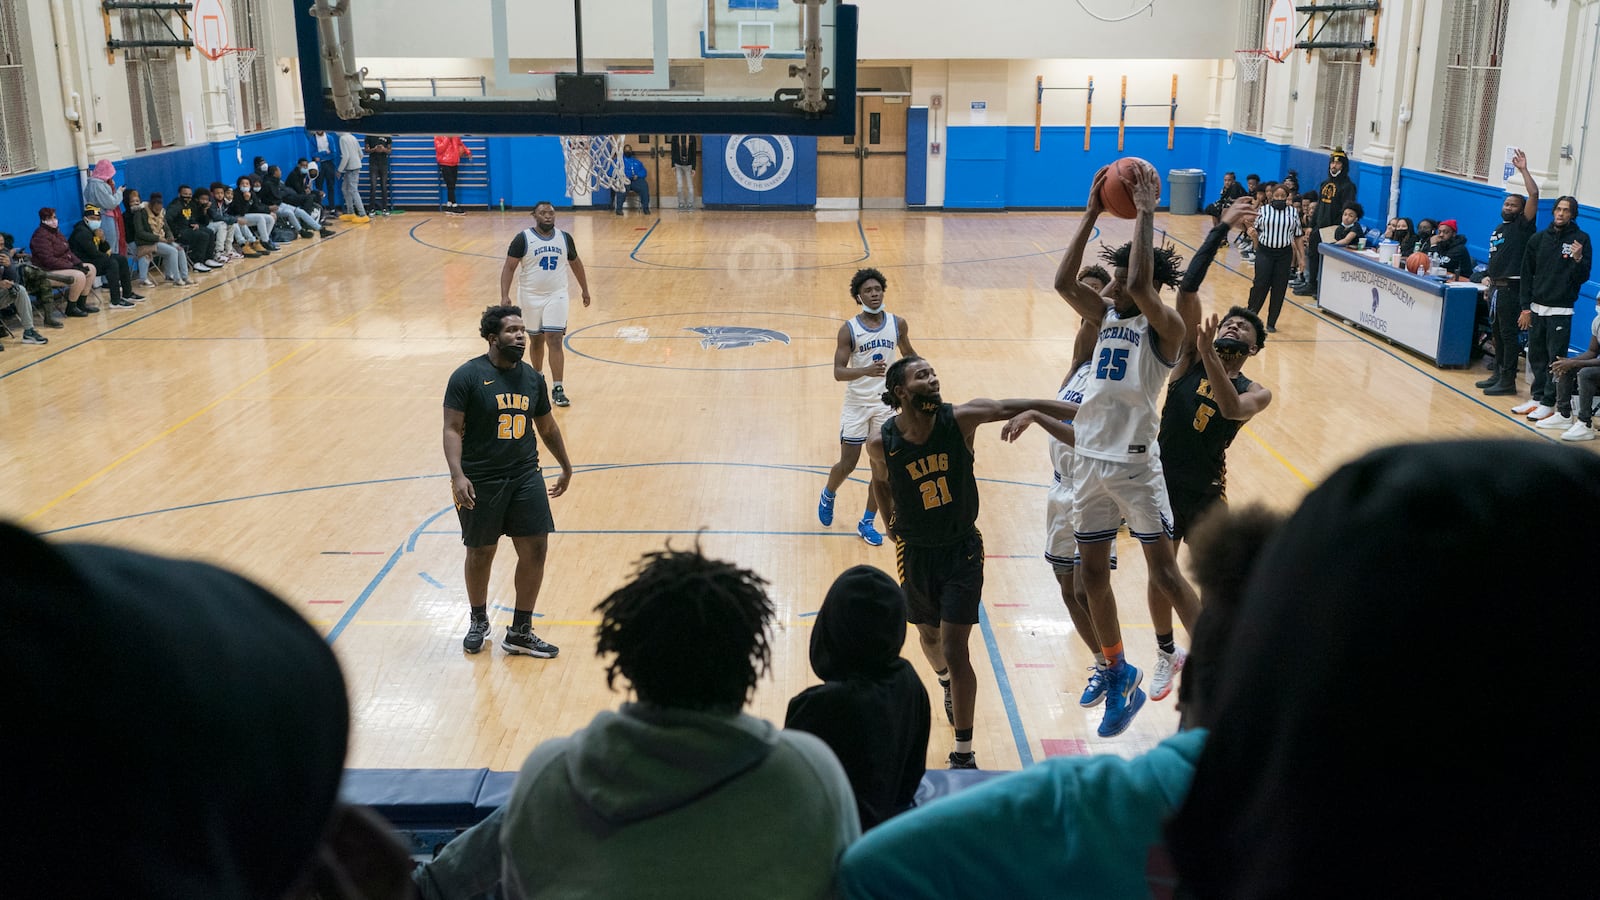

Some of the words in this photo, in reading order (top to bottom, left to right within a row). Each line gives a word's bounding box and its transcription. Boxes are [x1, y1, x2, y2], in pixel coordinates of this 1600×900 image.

[539, 256, 558, 270] 45
[1341, 270, 1367, 284] RICHARDS
[1367, 271, 1388, 290] CAREER
[1387, 282, 1416, 310] ACADEMY
[1360, 311, 1387, 332] WARRIORS
[859, 338, 894, 353] RICHARDS
[1096, 348, 1129, 380] 25
[495, 393, 530, 412] KING
[1063, 390, 1084, 404] RICH
[497, 413, 527, 440] 20
[1193, 403, 1216, 432] 5
[905, 452, 949, 480] KING
[919, 475, 953, 511] 21
